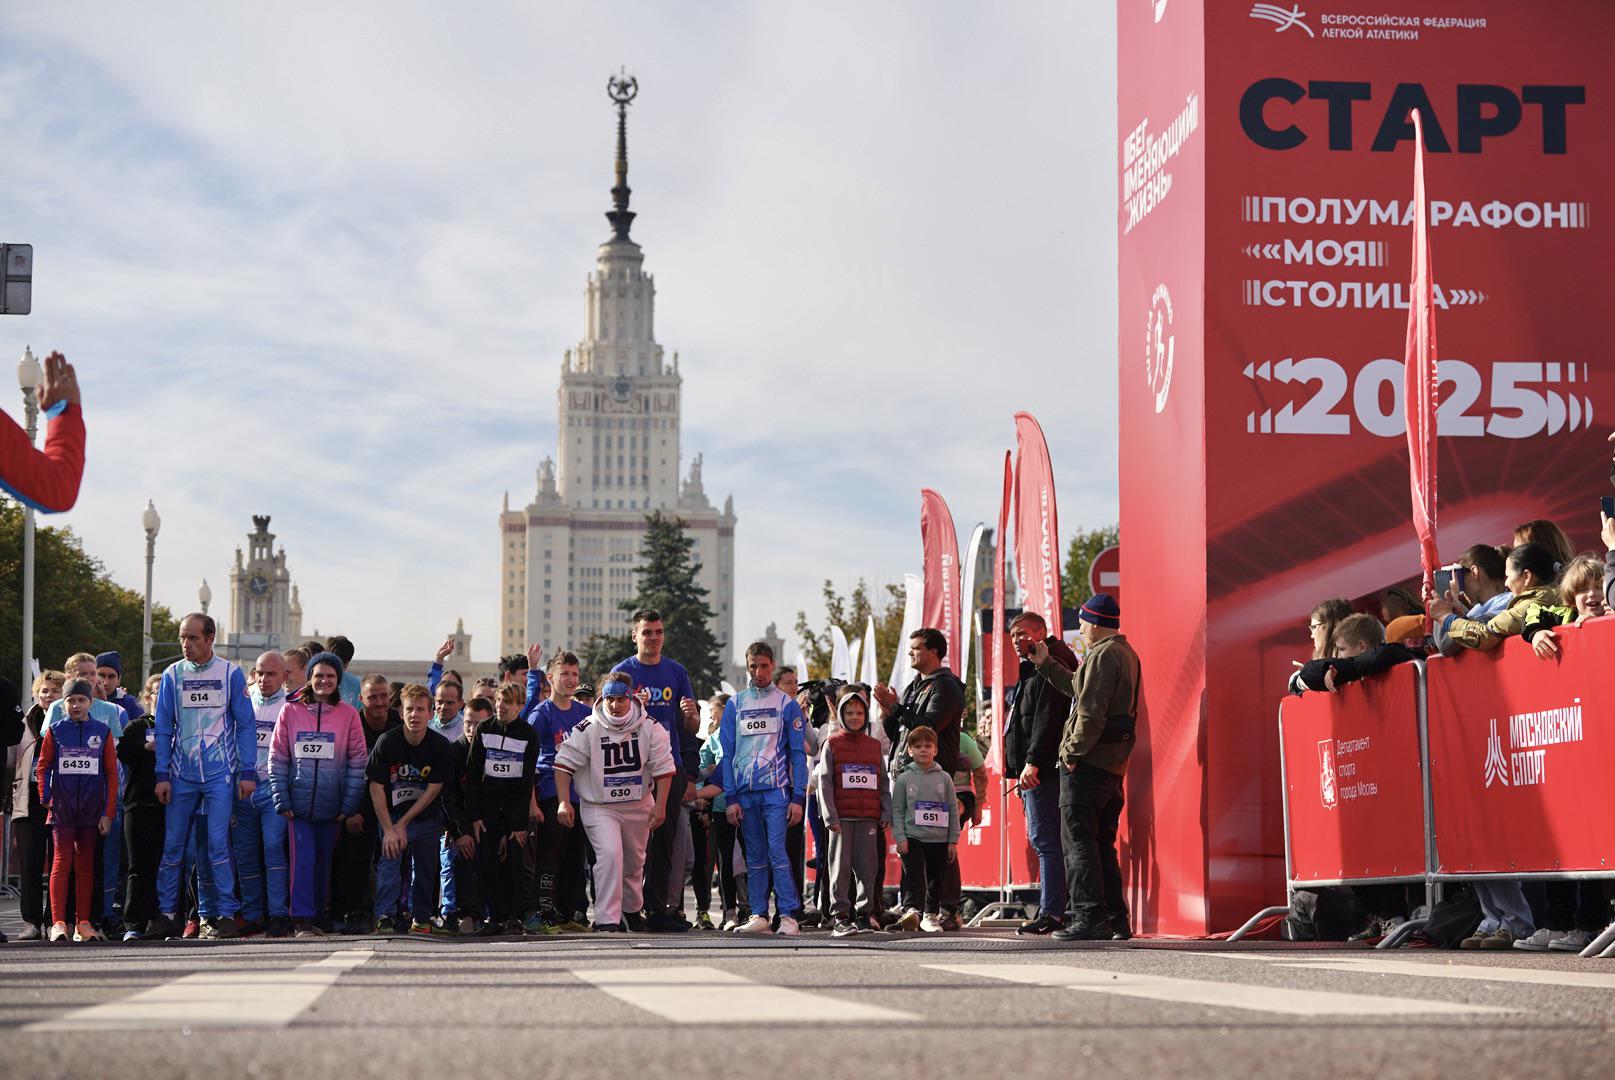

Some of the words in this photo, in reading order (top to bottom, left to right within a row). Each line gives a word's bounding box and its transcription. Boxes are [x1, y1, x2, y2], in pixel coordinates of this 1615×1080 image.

[1321, 14, 1420, 27] ВСЕРОССИЙСКАЯ
[1423, 17, 1487, 29] ФЕДЕРАЦИЯ
[1322, 26, 1364, 39] ЛЕГКОЙ
[1366, 29, 1419, 40] АТЛЕТИКИ
[1239, 77, 1586, 155] СТАРТ
[1128, 91, 1197, 196] МЕНЯЮЩИЙ
[1128, 168, 1168, 230] ЖИЗНЬ
[1274, 357, 1567, 439] 2025
[189, 693, 209, 702] 614
[747, 720, 767, 730] 608
[1509, 697, 1583, 749] МОСКОВСКИЙ
[256, 733, 267, 742] 07
[302, 744, 322, 753] 637
[1337, 736, 1370, 758] Департамент
[62, 760, 91, 769] 6439
[493, 763, 511, 773] 631
[1338, 763, 1356, 780] спорта
[1511, 749, 1546, 786] СПОРТ
[848, 775, 868, 784] 650
[610, 788, 631, 797] 630
[1340, 785, 1357, 804] города
[1357, 781, 1378, 797] Москвы
[922, 812, 940, 821] 651
